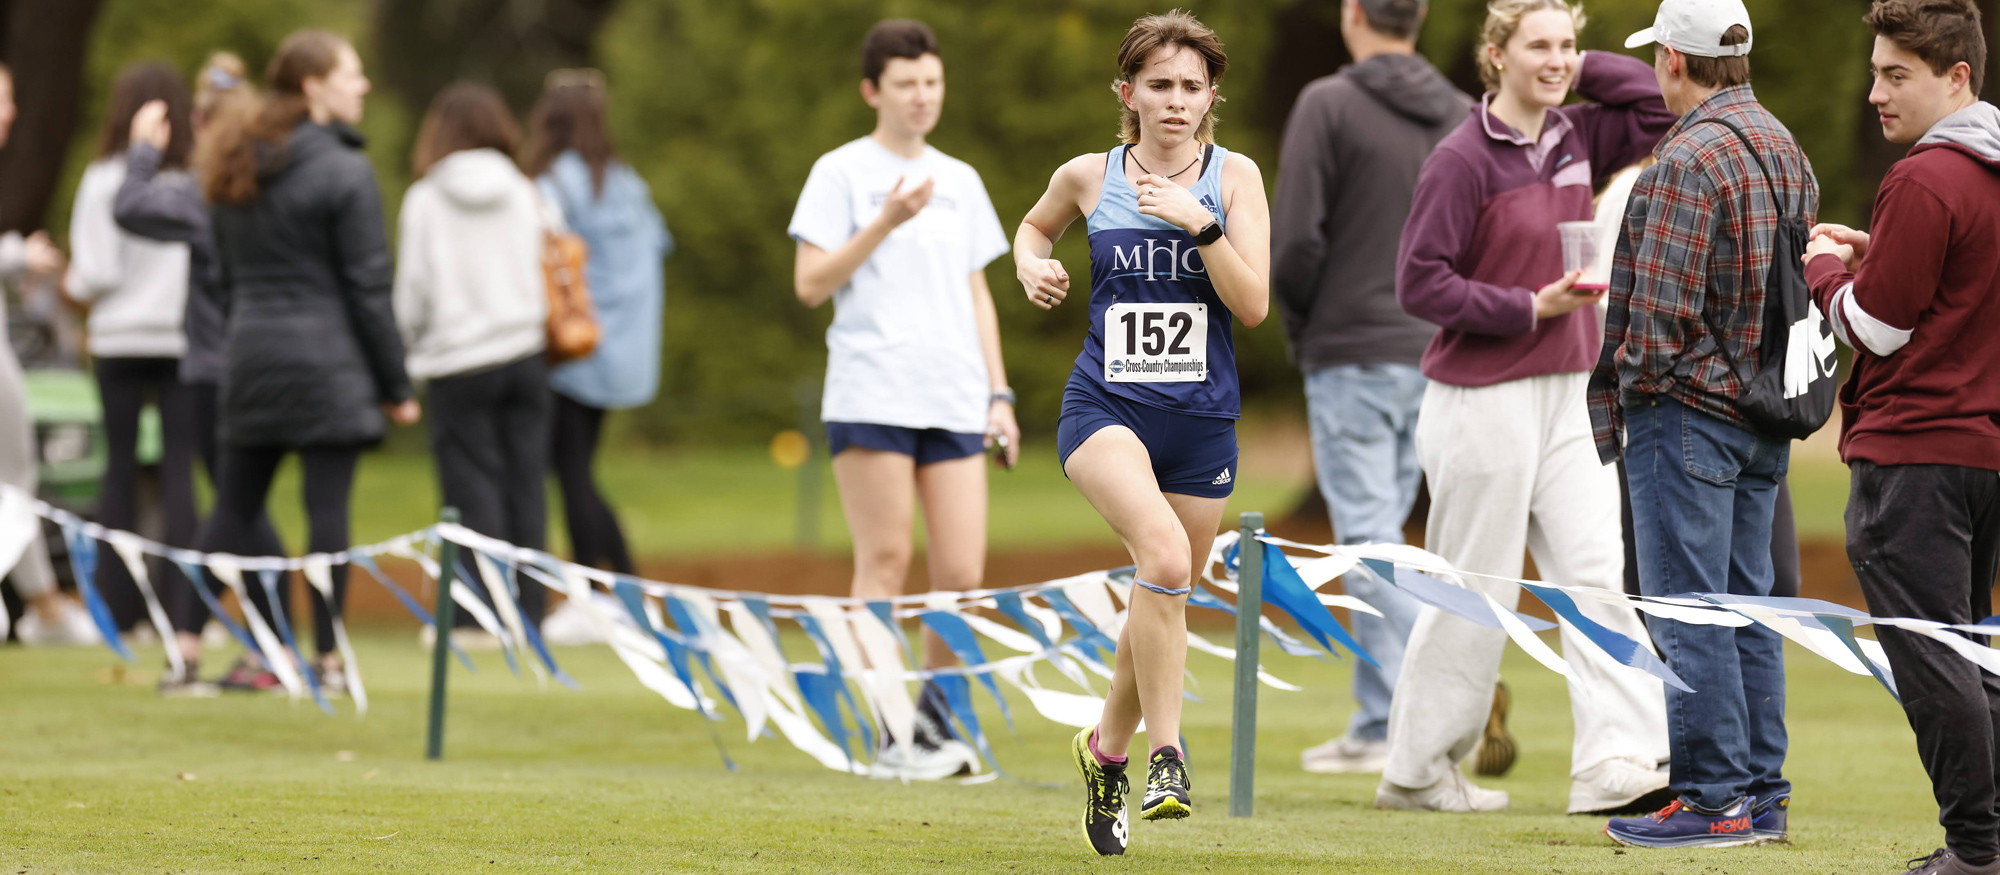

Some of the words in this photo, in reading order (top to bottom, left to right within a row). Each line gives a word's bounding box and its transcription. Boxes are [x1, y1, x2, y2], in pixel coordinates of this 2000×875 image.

[1112, 238, 1205, 281] MHC
[1120, 311, 1193, 356] 152
[1125, 359, 1163, 374] Cross-Country
[1164, 358, 1204, 375] Championships
[1710, 816, 1750, 834] HOKA
